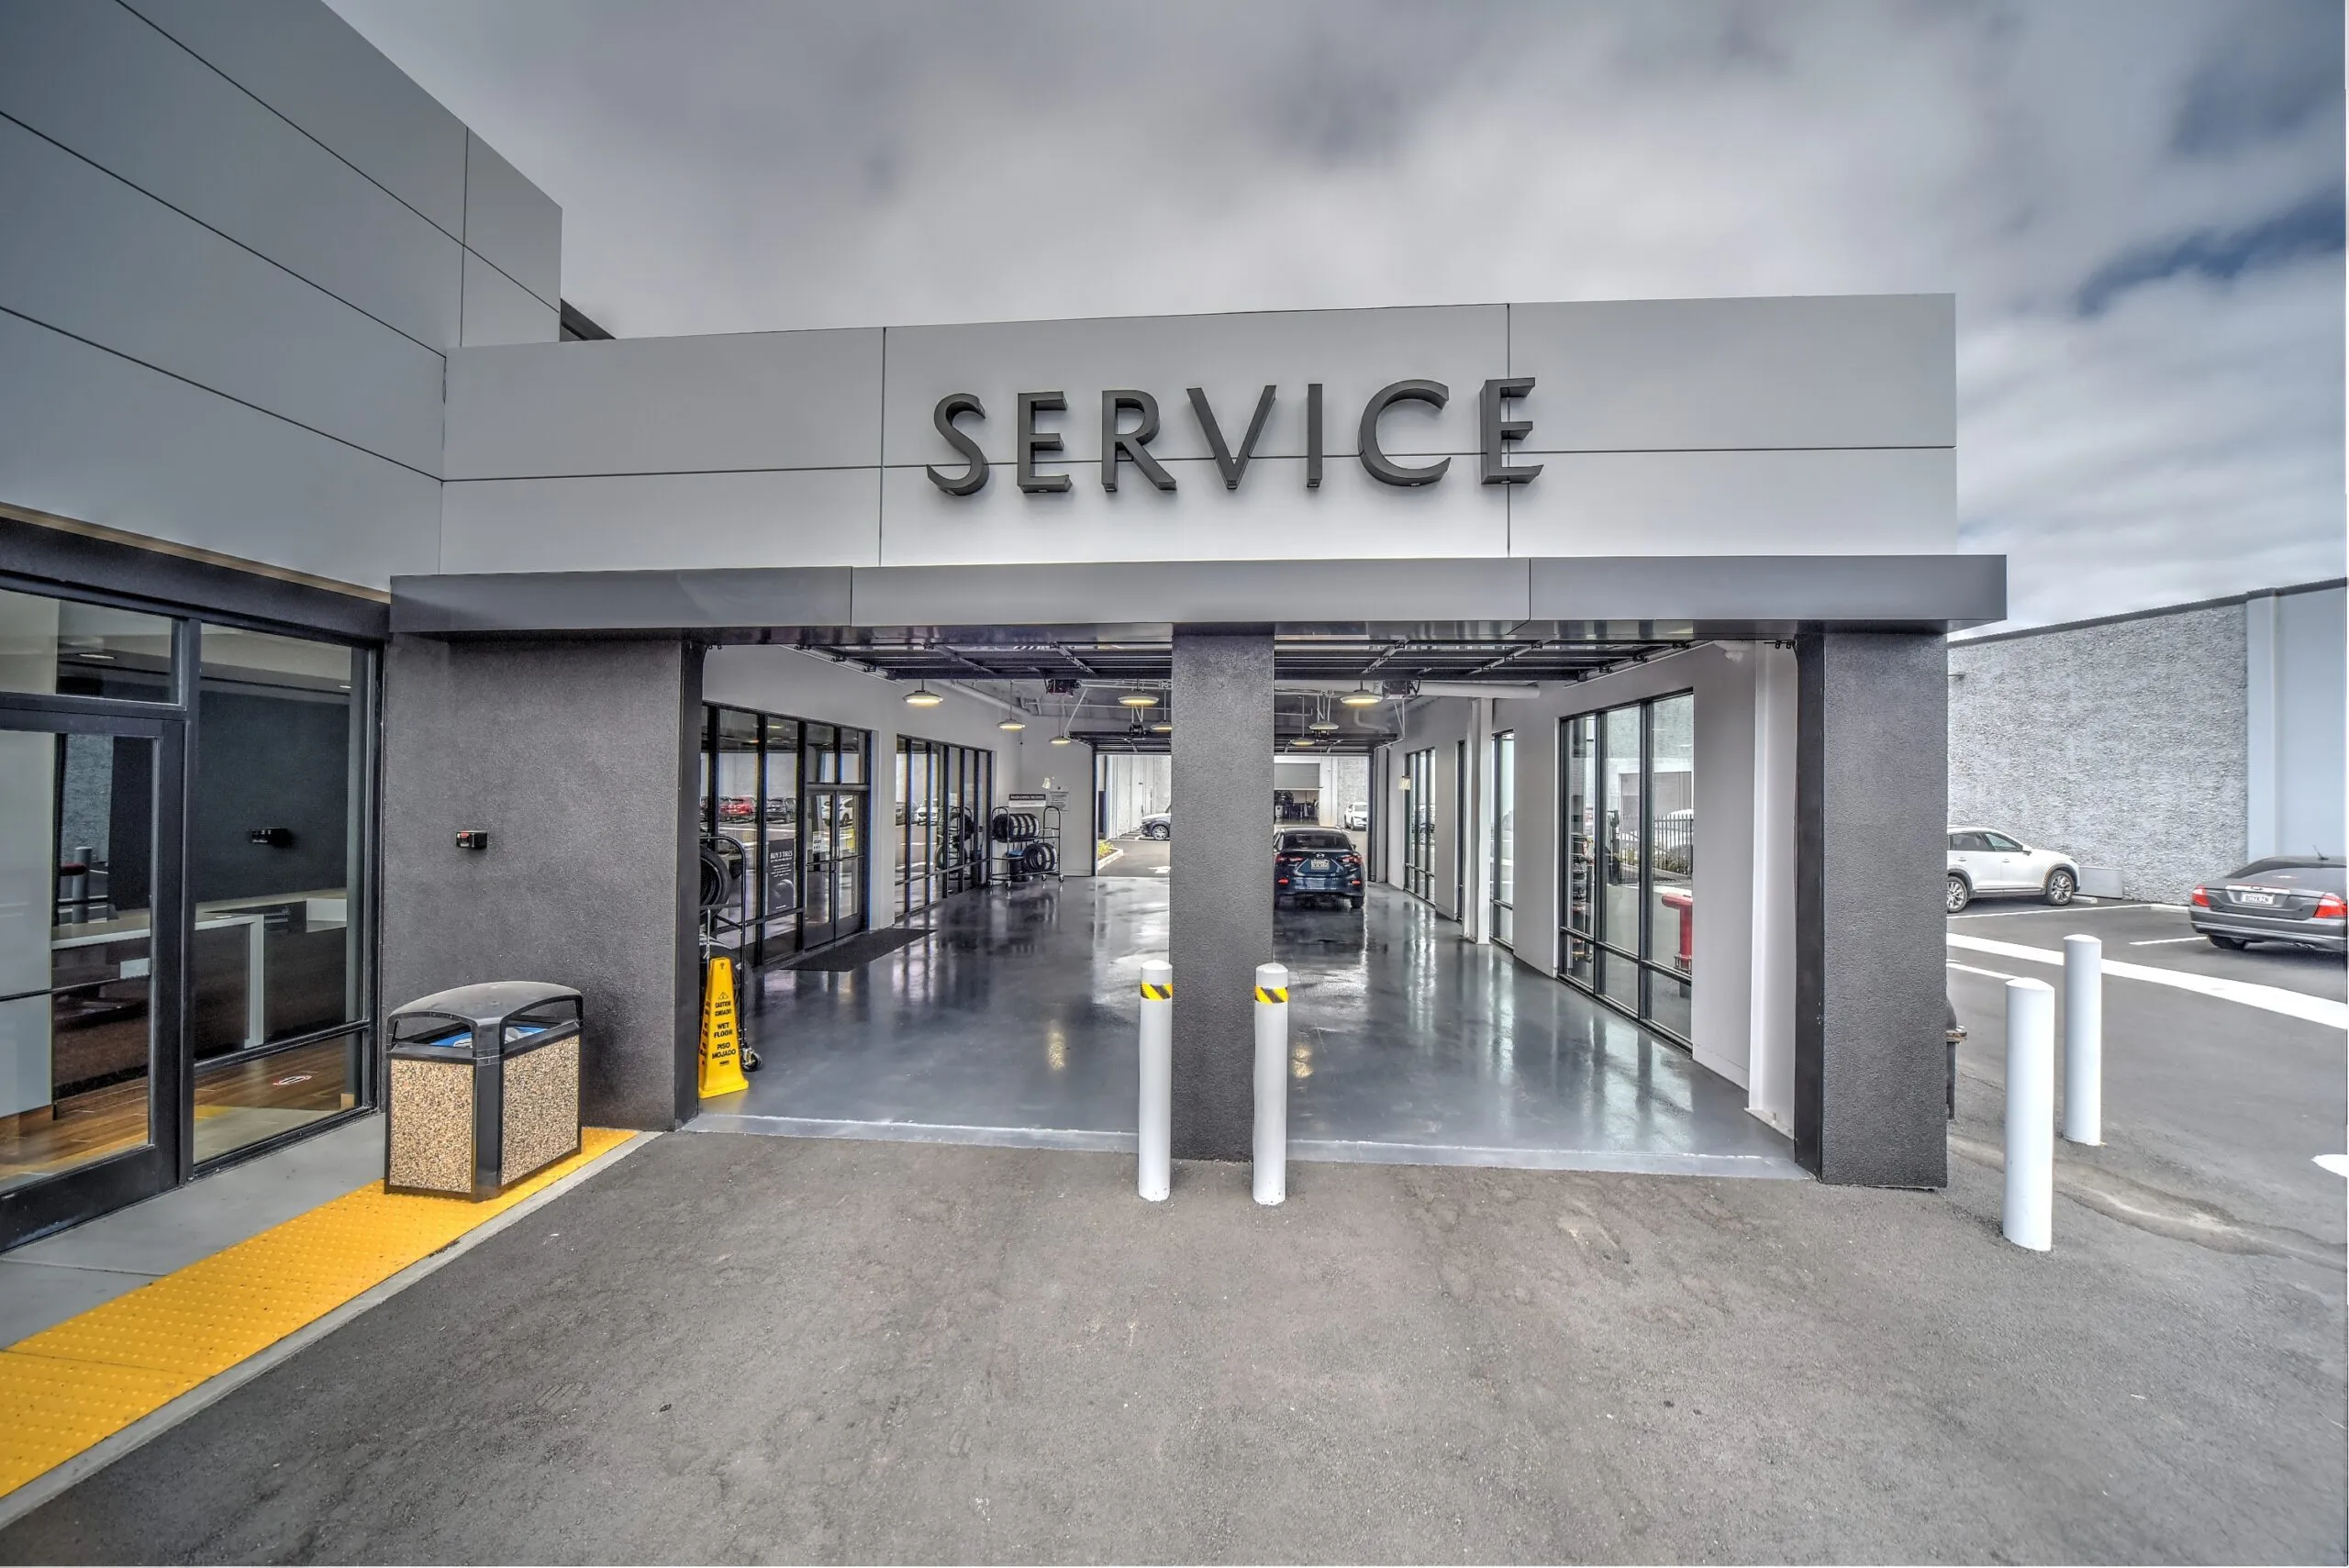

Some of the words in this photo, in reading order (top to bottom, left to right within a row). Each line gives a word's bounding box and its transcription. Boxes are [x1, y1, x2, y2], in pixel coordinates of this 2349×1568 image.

[926, 377, 1544, 496] SERVICE
[714, 1029, 733, 1038] FLOOR
[712, 1049, 736, 1059] MOJADO
